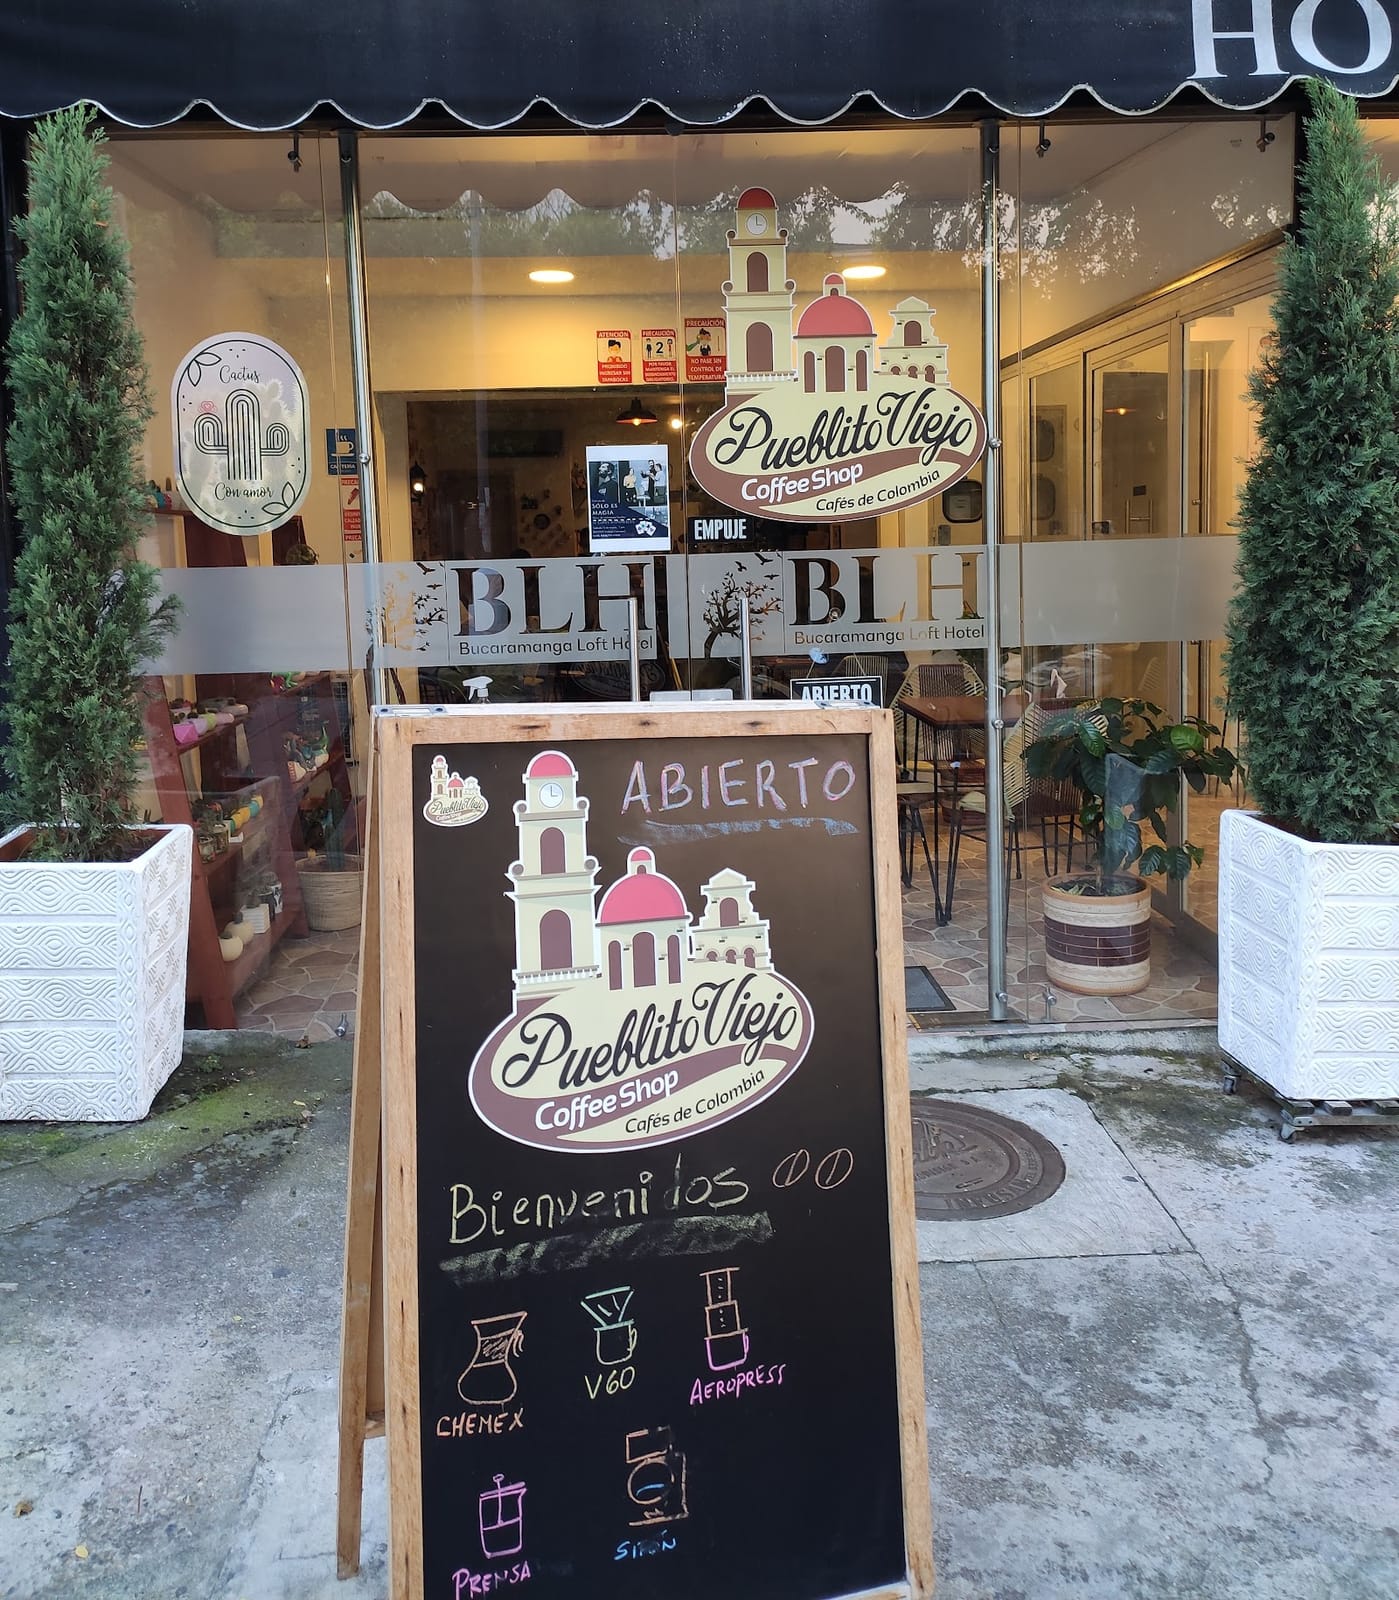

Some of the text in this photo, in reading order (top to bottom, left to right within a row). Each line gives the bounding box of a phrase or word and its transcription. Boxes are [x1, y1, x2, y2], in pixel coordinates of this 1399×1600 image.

[655, 342, 664, 354] 2
[219, 365, 260, 384] Cactus
[714, 387, 972, 470] Pueblito Viejo
[214, 482, 274, 501] Con amor
[741, 463, 864, 504] Coffee Shop
[816, 468, 941, 513] Cafés de Colombia
[694, 518, 747, 540] EMPUJE
[451, 563, 653, 636] BLH
[788, 552, 984, 626] BLH
[459, 635, 653, 656] Bucaramanga Loft Hoel
[794, 624, 984, 645] Bucaramanga Loft Hotel
[802, 683, 873, 701] ABIERTO
[621, 757, 856, 815] ABIERTO
[502, 973, 797, 1089] Pueblito Viejo
[535, 1069, 679, 1131] Coffee Shop
[625, 1069, 765, 1135] Cafés de Colombia
[449, 1152, 749, 1244] Bienvenidos
[584, 1366, 636, 1399] V60
[689, 1363, 787, 1406] AEROPRESS
[436, 1407, 524, 1437] CHEMEX
[451, 1560, 531, 1600] PRENSA
